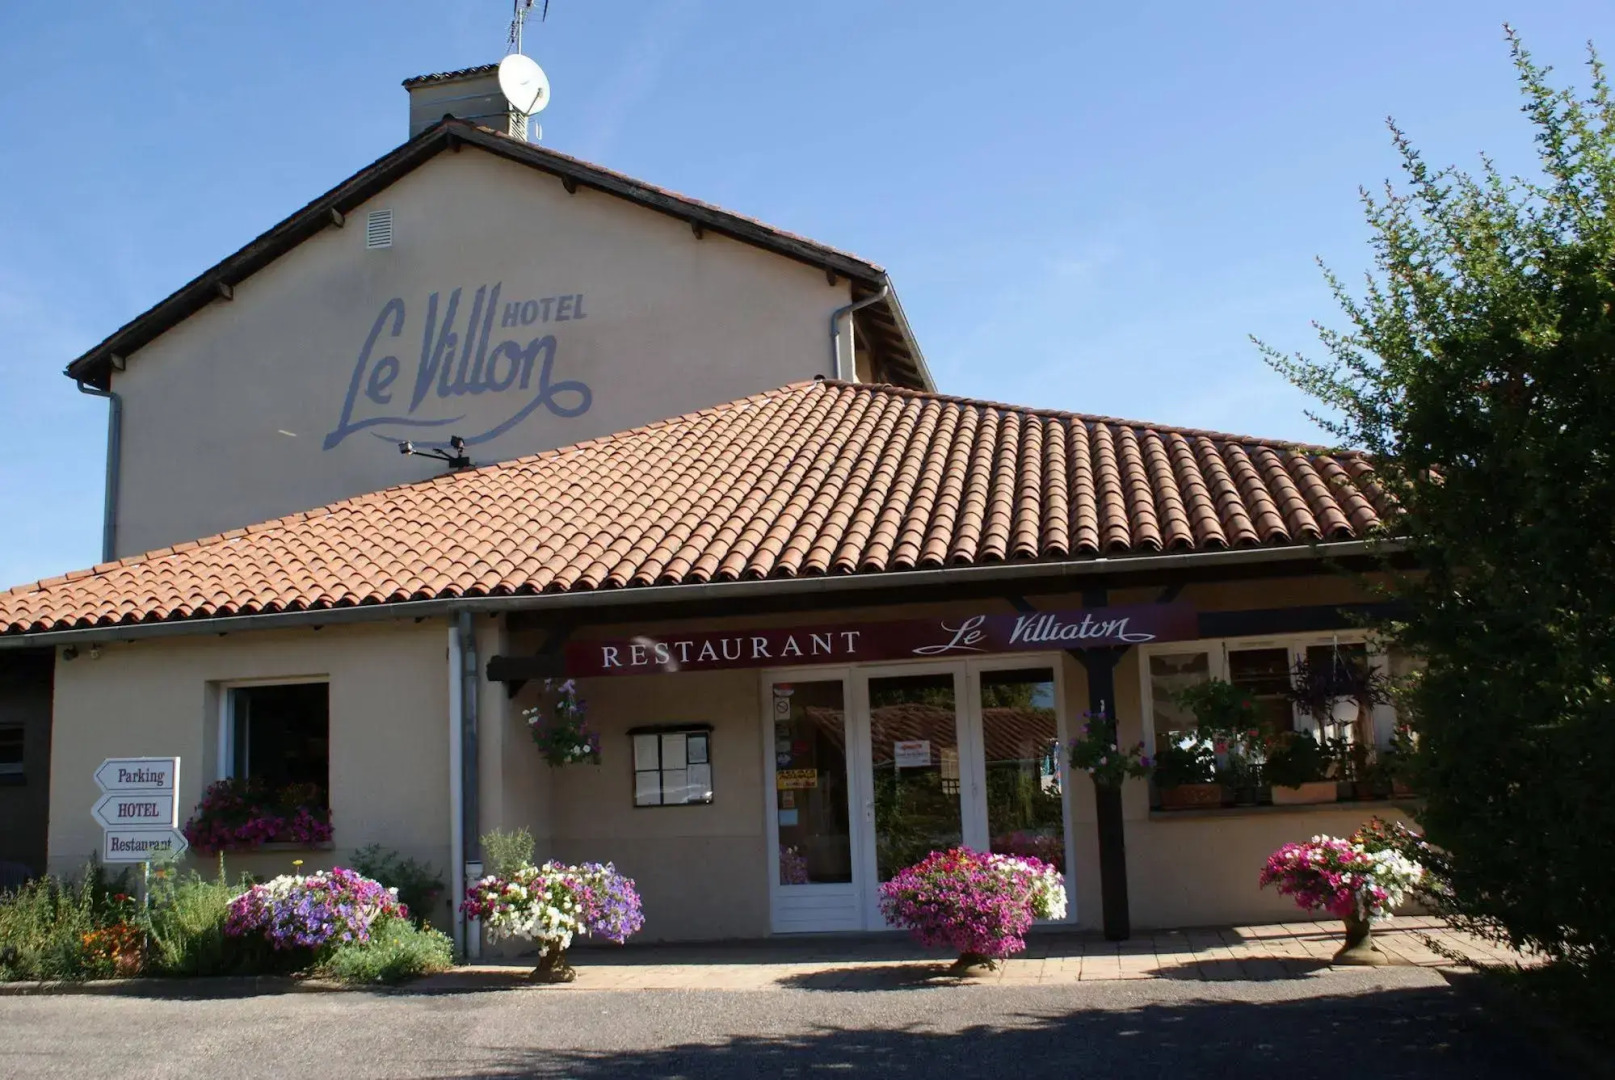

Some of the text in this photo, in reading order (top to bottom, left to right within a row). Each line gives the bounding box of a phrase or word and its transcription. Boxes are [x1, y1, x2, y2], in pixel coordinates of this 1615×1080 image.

[501, 294, 587, 328] HOTEL
[322, 281, 592, 450] Le Villon
[601, 613, 1156, 668] RESTAURANT Le Villiaton
[118, 768, 165, 786] Parking
[117, 803, 160, 818] HOTEL
